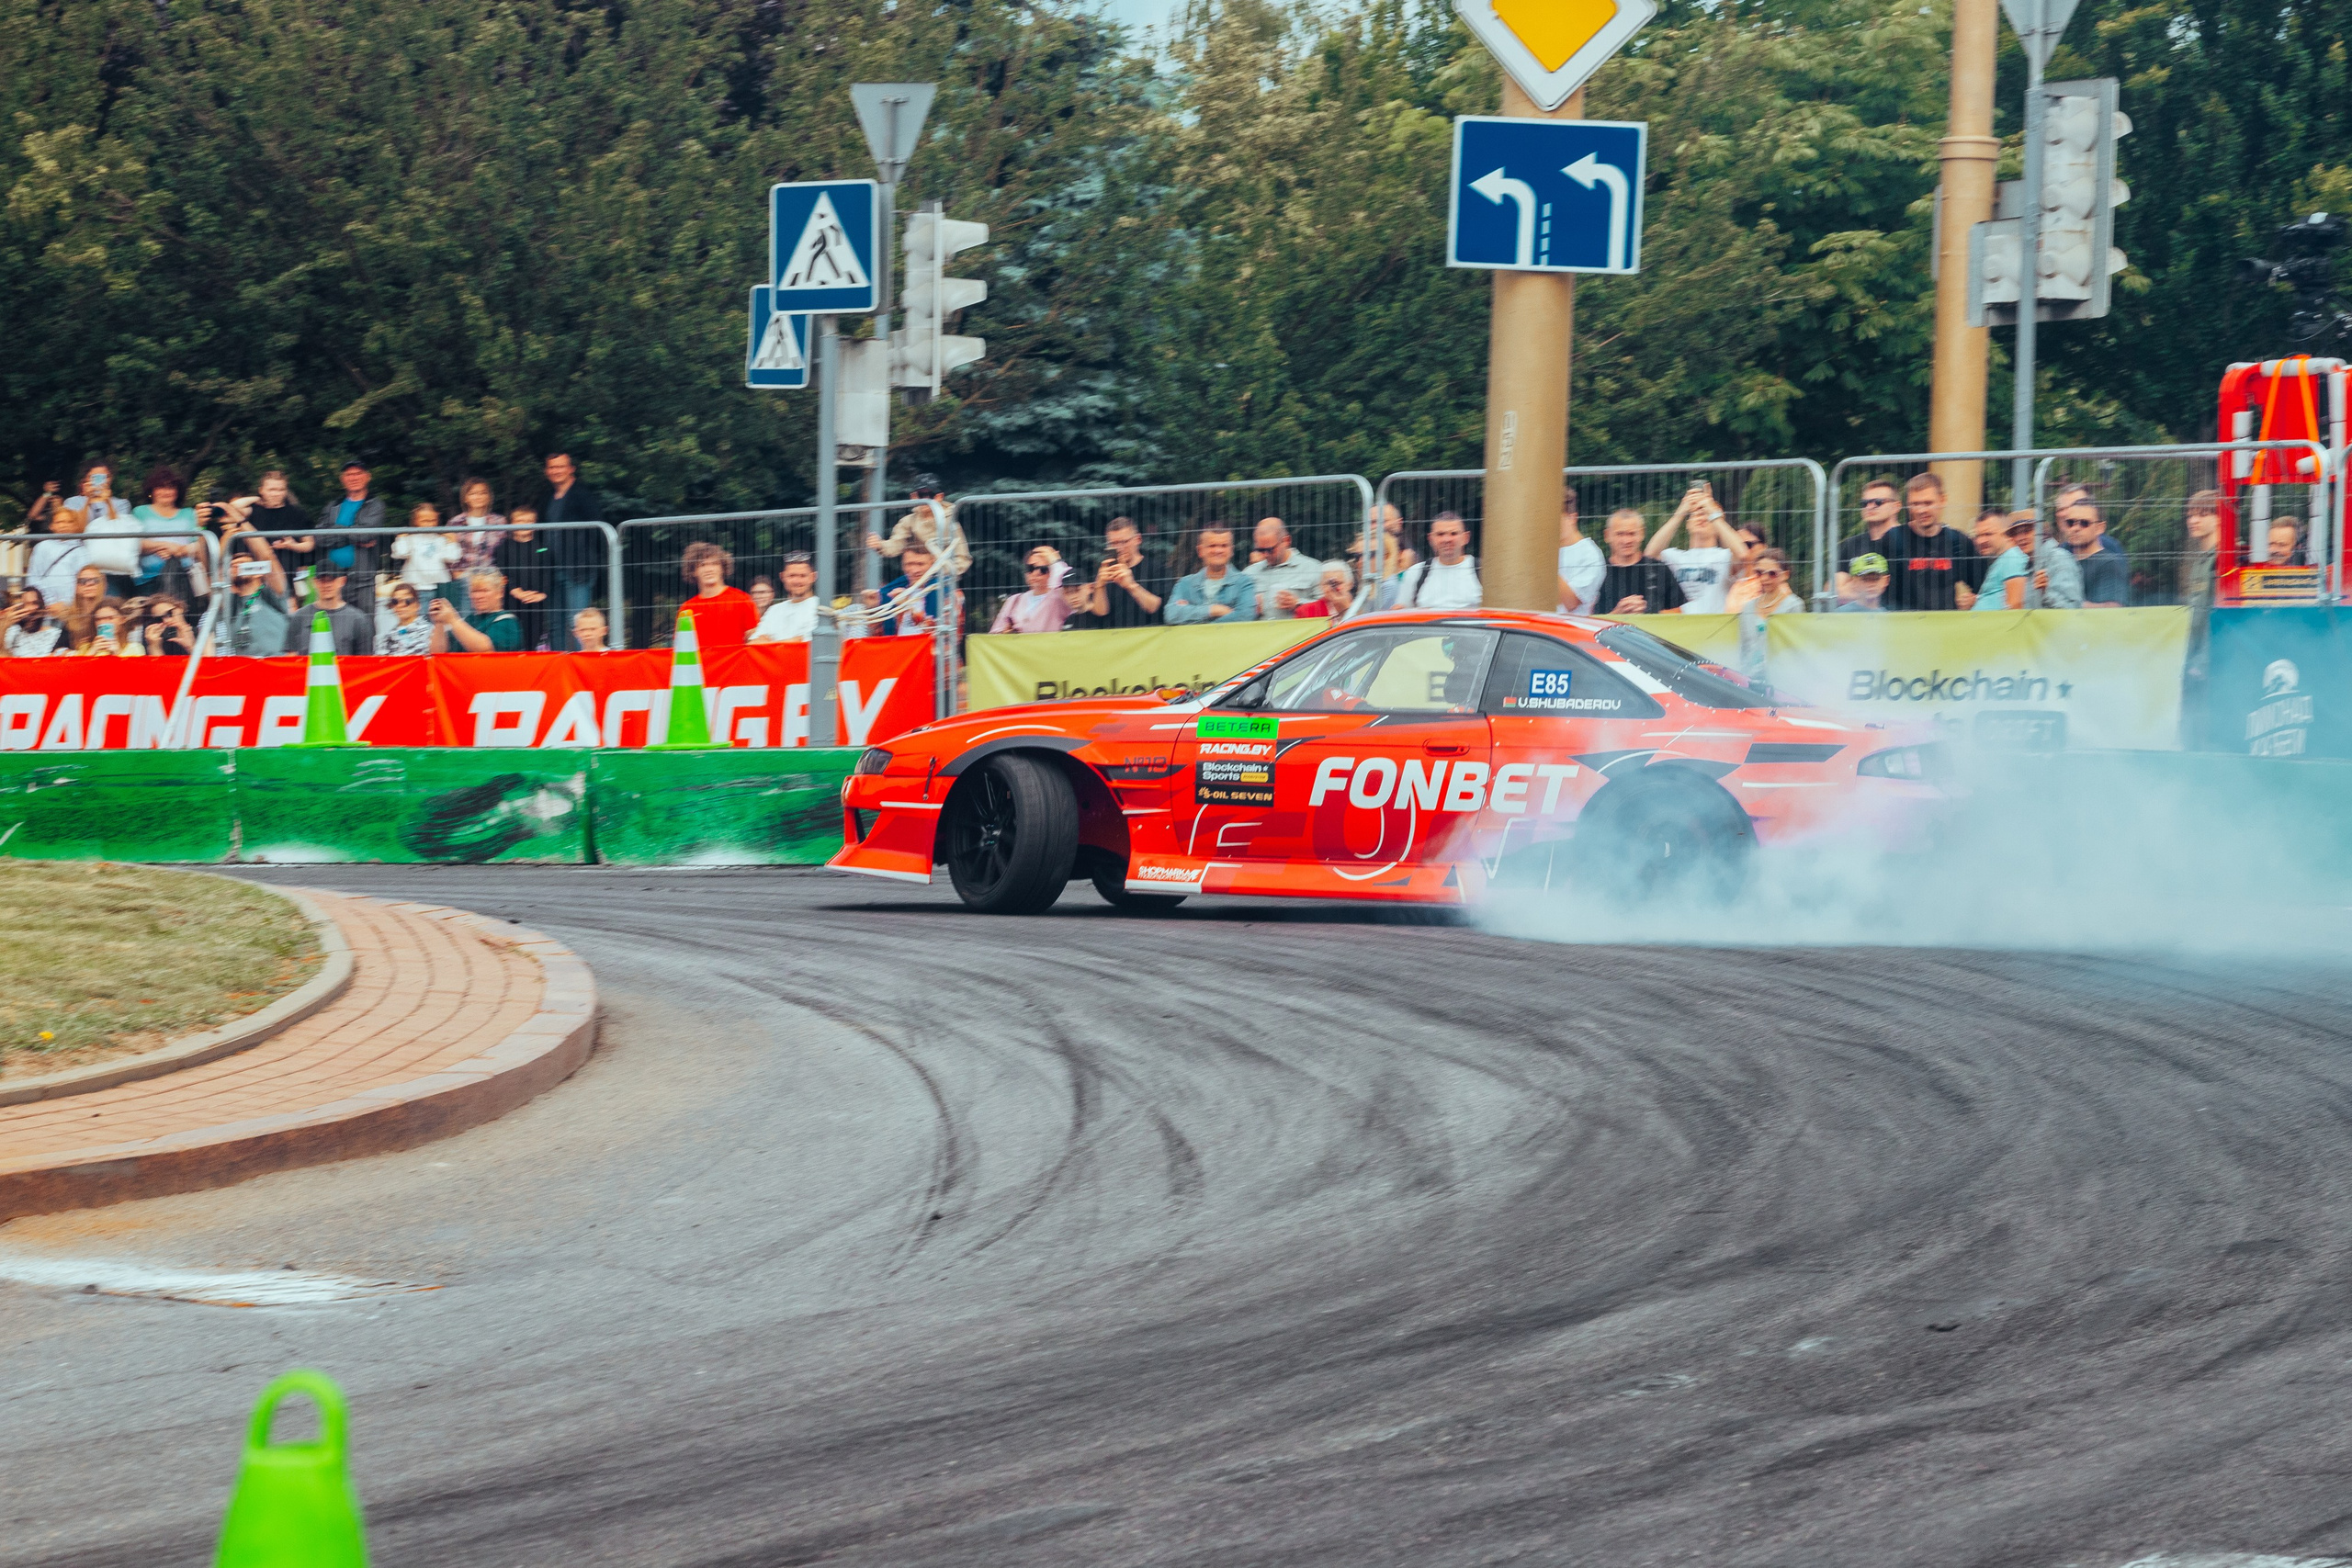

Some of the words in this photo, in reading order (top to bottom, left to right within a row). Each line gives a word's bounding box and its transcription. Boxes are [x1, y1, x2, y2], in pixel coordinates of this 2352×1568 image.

[1532, 672, 1569, 694] E85
[1848, 669, 2049, 701] Blockchain
[1205, 721, 1271, 733] BETERA
[1200, 743, 1272, 756] RACING.BY
[1203, 761, 1262, 773] Blockchain
[1203, 772, 1240, 782] Sports
[1308, 757, 1580, 815] FONBET
[1231, 791, 1272, 802] SEVEN
